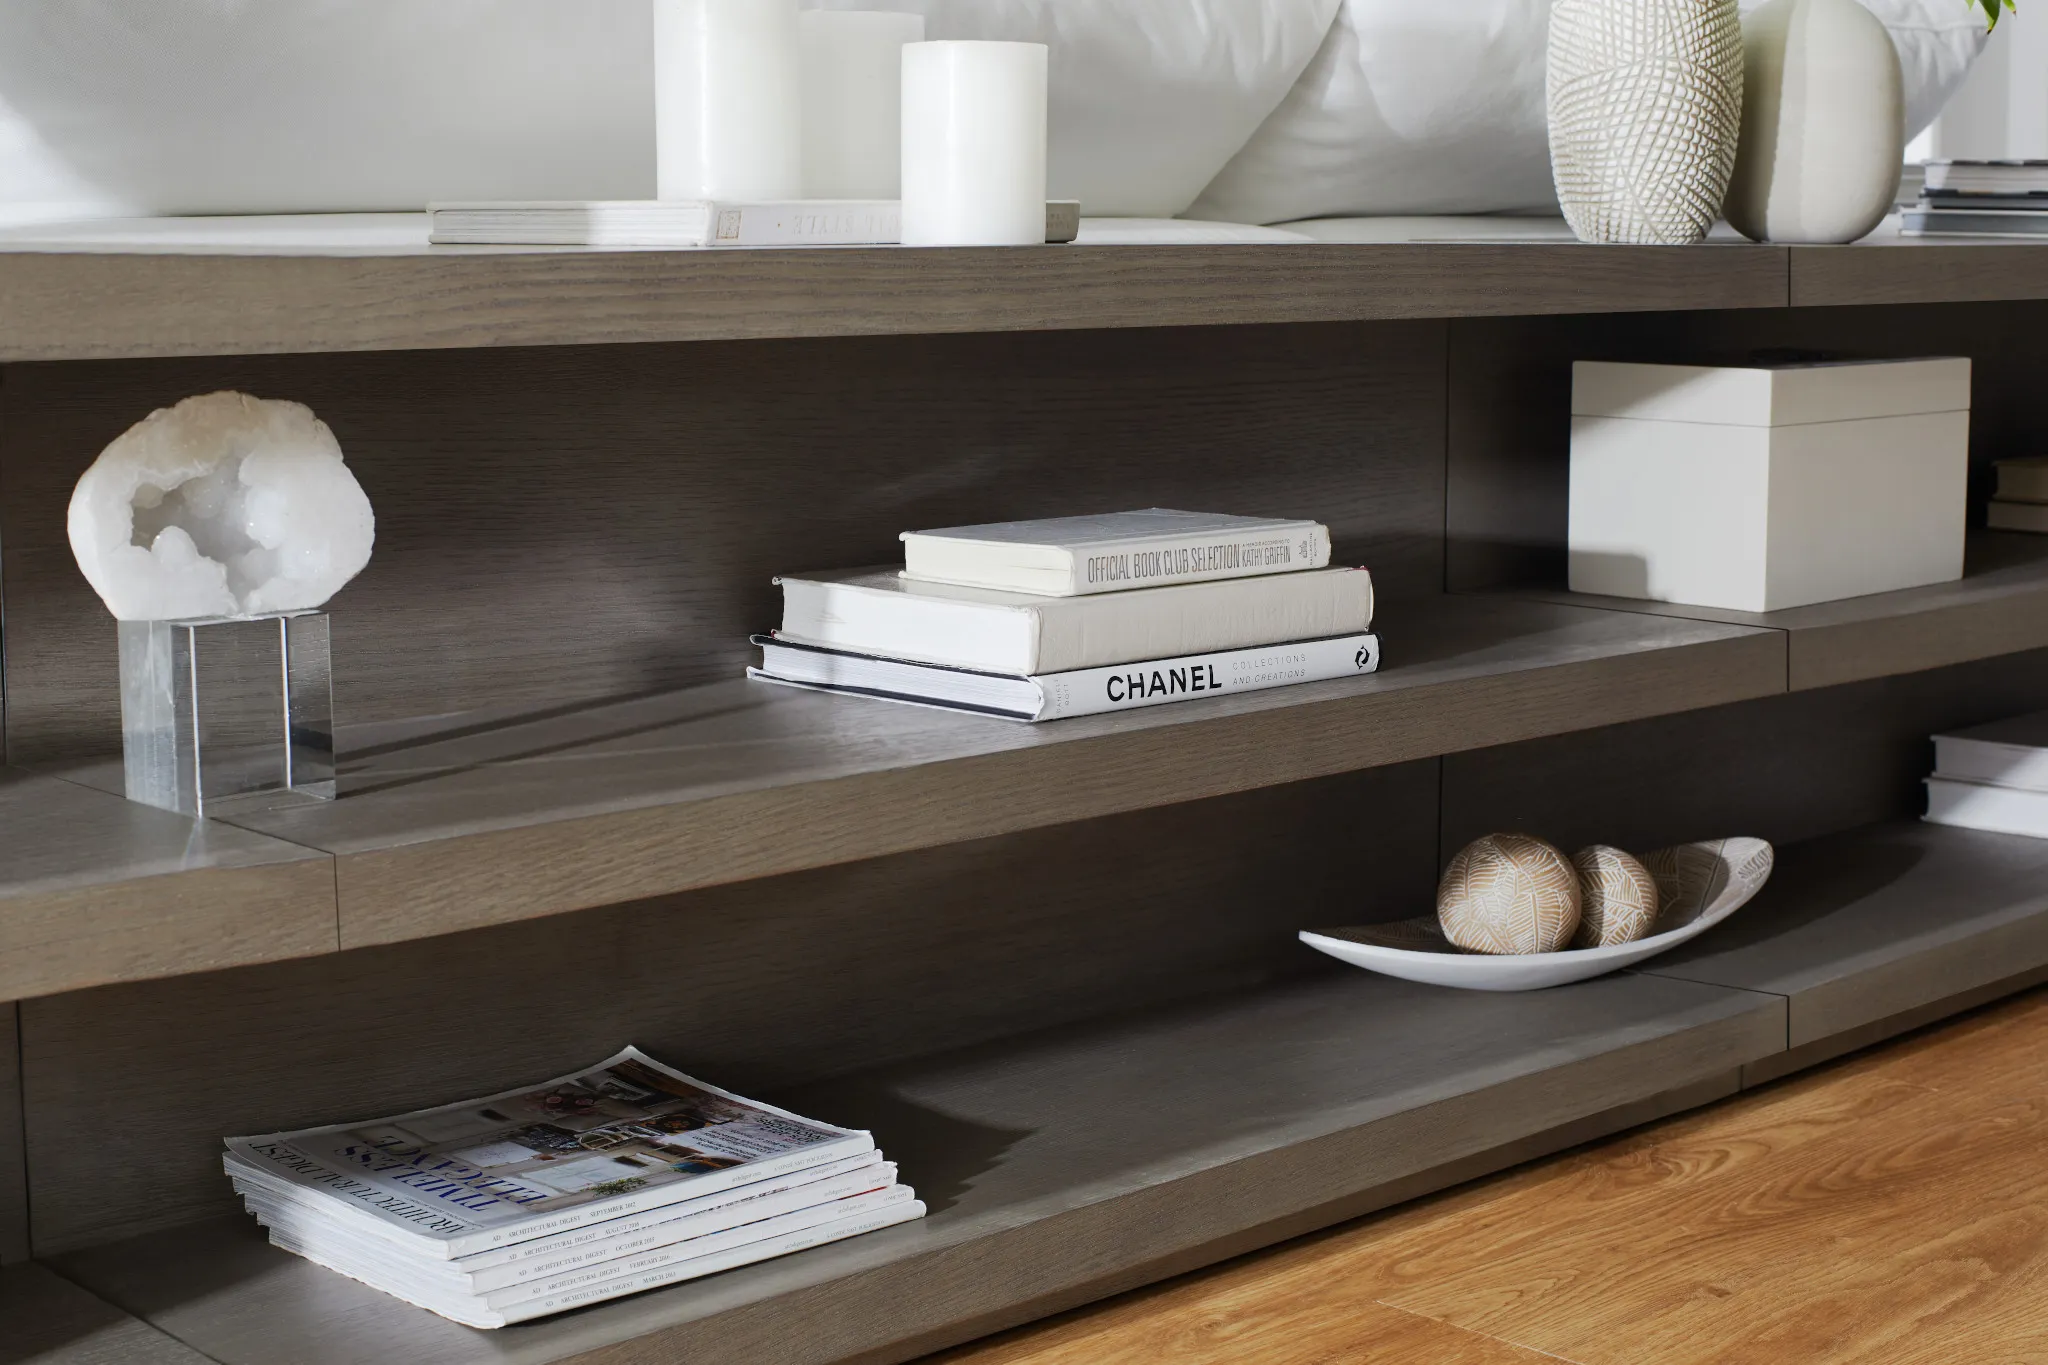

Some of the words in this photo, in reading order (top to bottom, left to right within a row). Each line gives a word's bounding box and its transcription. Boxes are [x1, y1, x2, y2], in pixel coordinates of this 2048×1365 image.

[1087, 554, 1131, 583] OFFICIAL
[1133, 551, 1162, 579] BOOK
[1163, 548, 1189, 576] CLUB
[1191, 543, 1240, 573] SELECTION
[1241, 548, 1263, 568] KATHY
[1264, 545, 1291, 566] GRIFFIN
[1232, 653, 1306, 671] COLLECTIONS
[1232, 675, 1251, 686] AND
[1254, 668, 1306, 683] CREATIONS
[1106, 664, 1223, 702] CHANEL
[248, 1143, 325, 1174] DIGEST
[362, 1134, 549, 1205] ELEGANCE
[334, 1145, 500, 1212] TIMELESS
[312, 1171, 475, 1233] ARCHITECTURAL
[508, 1220, 559, 1238] ARCHITECTURAL
[559, 1216, 581, 1225] DIGEST
[589, 1206, 624, 1218] SEPTEMBER
[523, 1239, 574, 1256] ARCHITECTURAL
[574, 1233, 597, 1243] DIGEST
[604, 1224, 628, 1235] AUGUST
[533, 1255, 583, 1273] ARCHITECTURAL
[585, 1249, 608, 1260] DIGEST
[615, 1240, 643, 1251] OCTOBER
[547, 1273, 597, 1290] ARCHITECTURAL
[599, 1267, 620, 1277] DIGEST
[629, 1257, 658, 1269] FEBRUARY
[560, 1287, 611, 1304] ARCHITECTURAL
[612, 1281, 634, 1291] DIGEST
[642, 1274, 664, 1284] MARCH
